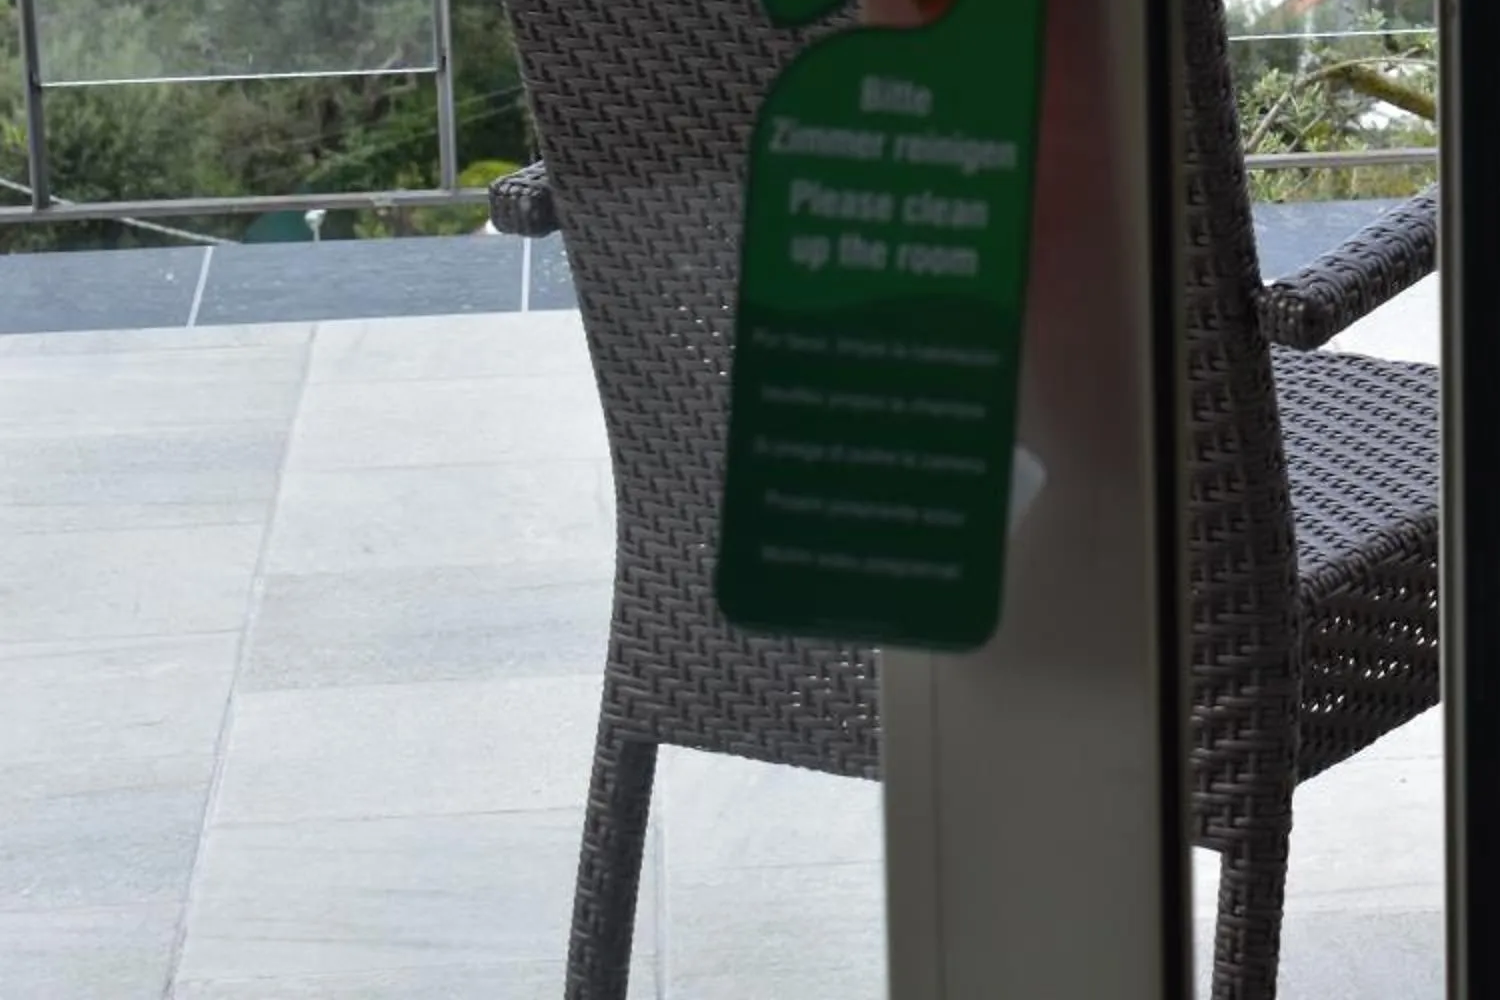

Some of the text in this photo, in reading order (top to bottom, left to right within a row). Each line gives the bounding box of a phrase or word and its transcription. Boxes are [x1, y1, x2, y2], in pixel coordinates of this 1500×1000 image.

[861, 75, 933, 116] Bitte
[770, 118, 1016, 175] Zimmer reinigen
[790, 180, 988, 228] Please clean
[790, 233, 978, 275] up the room
